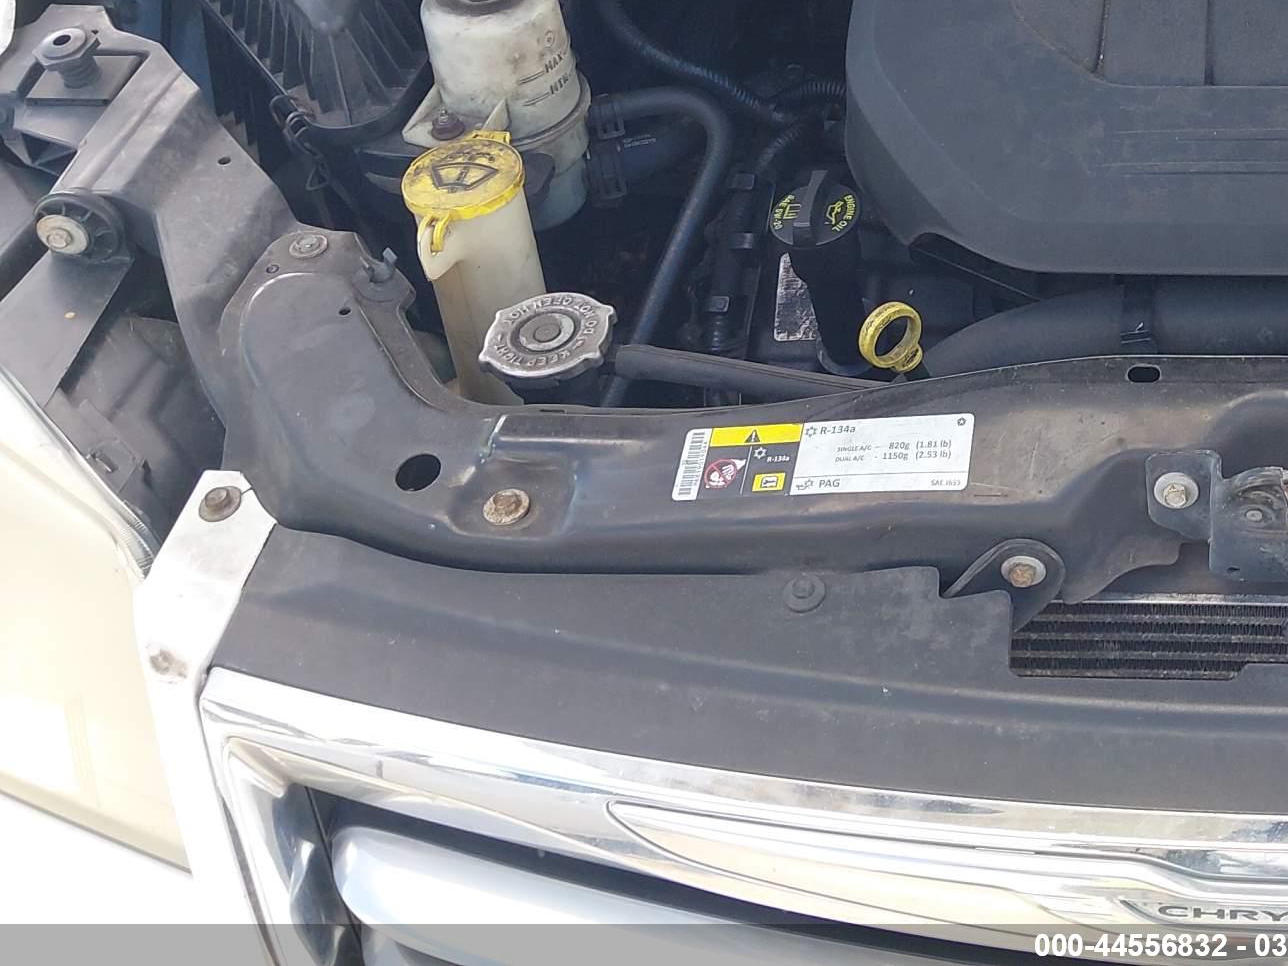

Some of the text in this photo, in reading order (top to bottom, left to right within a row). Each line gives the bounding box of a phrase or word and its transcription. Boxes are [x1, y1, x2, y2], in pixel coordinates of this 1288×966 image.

[544, 50, 564, 74] MAX
[778, 194, 795, 208] SAE
[831, 194, 857, 232] ENGINE OIL
[527, 349, 571, 368] KEEP
[820, 425, 856, 435] R-134a
[889, 441, 911, 451] 820g
[915, 440, 938, 450] (1.81
[940, 439, 953, 449] lb)
[767, 455, 790, 463] R-134a
[882, 451, 910, 461] 1150g
[915, 450, 938, 460] (2.53
[939, 449, 952, 459] lb)
[818, 479, 841, 489] PAG
